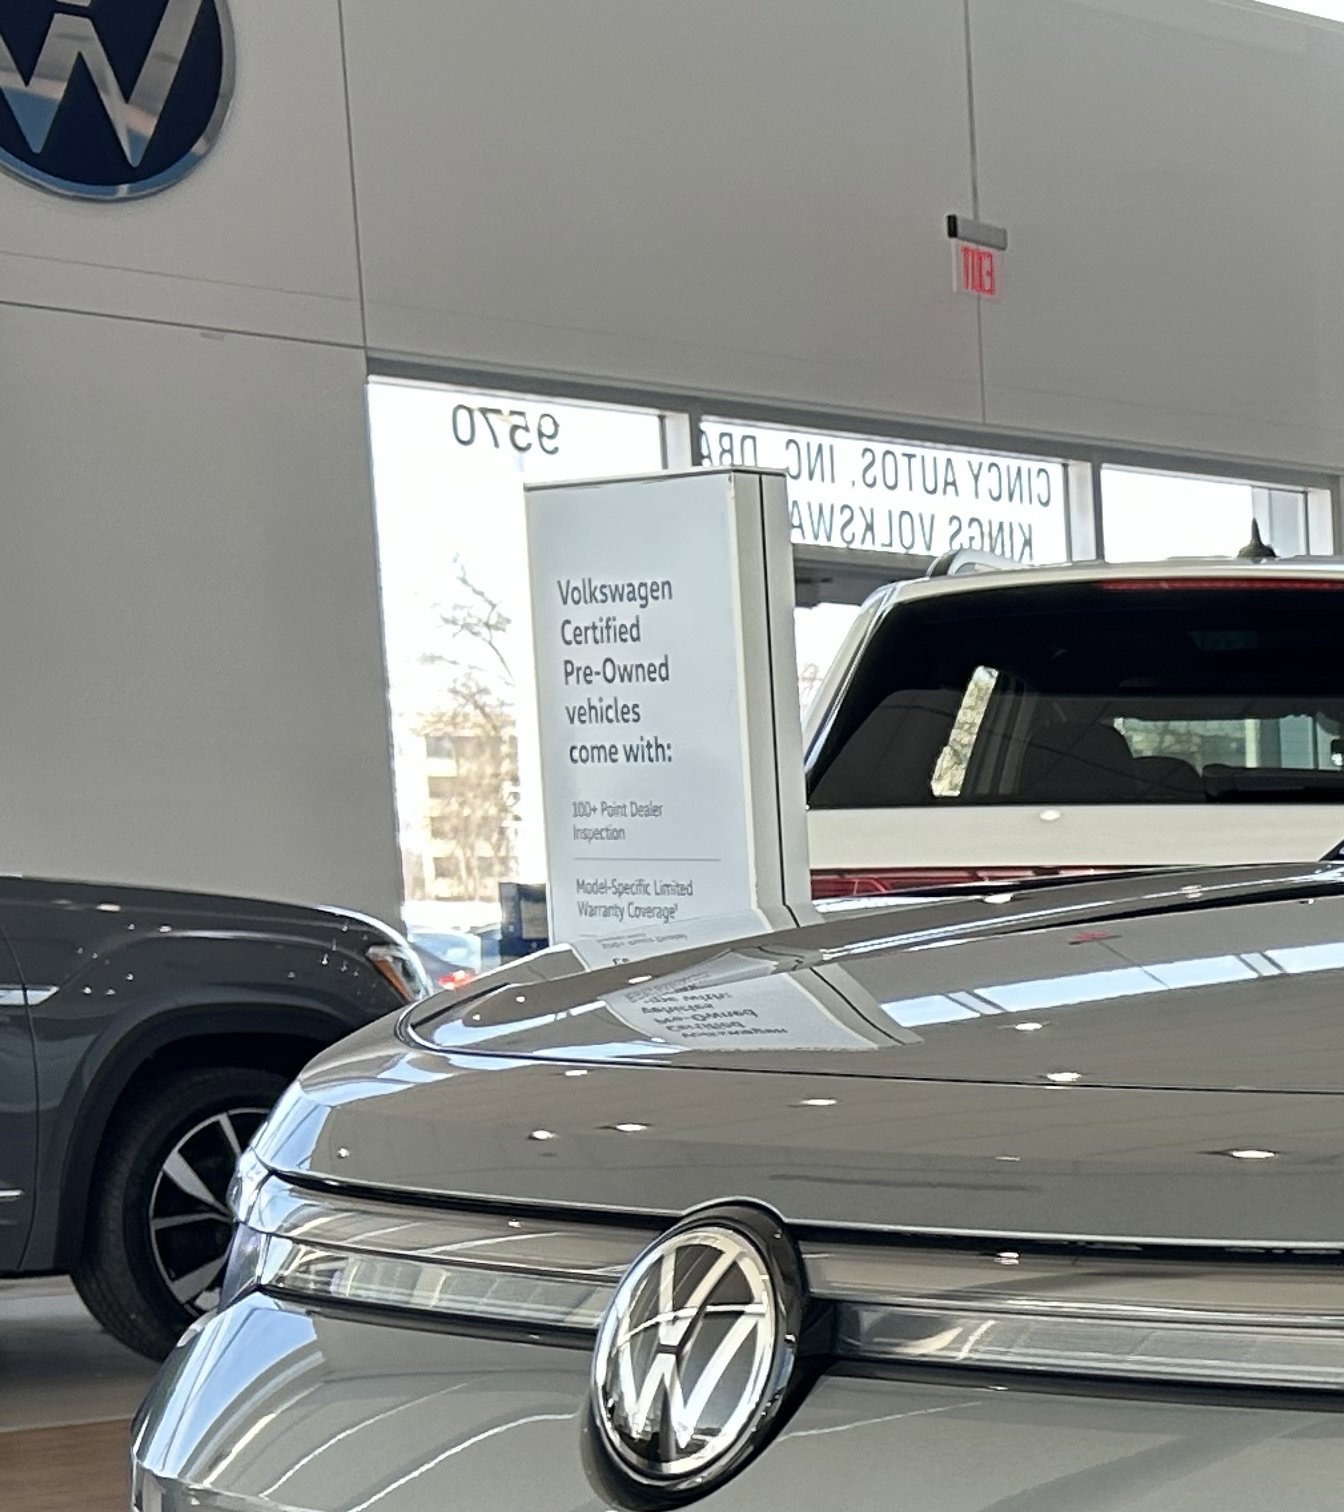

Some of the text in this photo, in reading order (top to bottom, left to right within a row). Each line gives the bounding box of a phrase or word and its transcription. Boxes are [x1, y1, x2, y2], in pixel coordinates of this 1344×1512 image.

[557, 577, 673, 609] Volkswagen
[561, 614, 641, 645] Certified
[563, 654, 670, 685] Pre-Owned
[565, 697, 641, 724] vehicles
[569, 735, 672, 764] come with:
[601, 801, 627, 818] Point
[630, 800, 663, 818] Dealer
[573, 825, 626, 844] Inspection
[654, 879, 694, 896] Limited
[577, 901, 625, 922] Warranty
